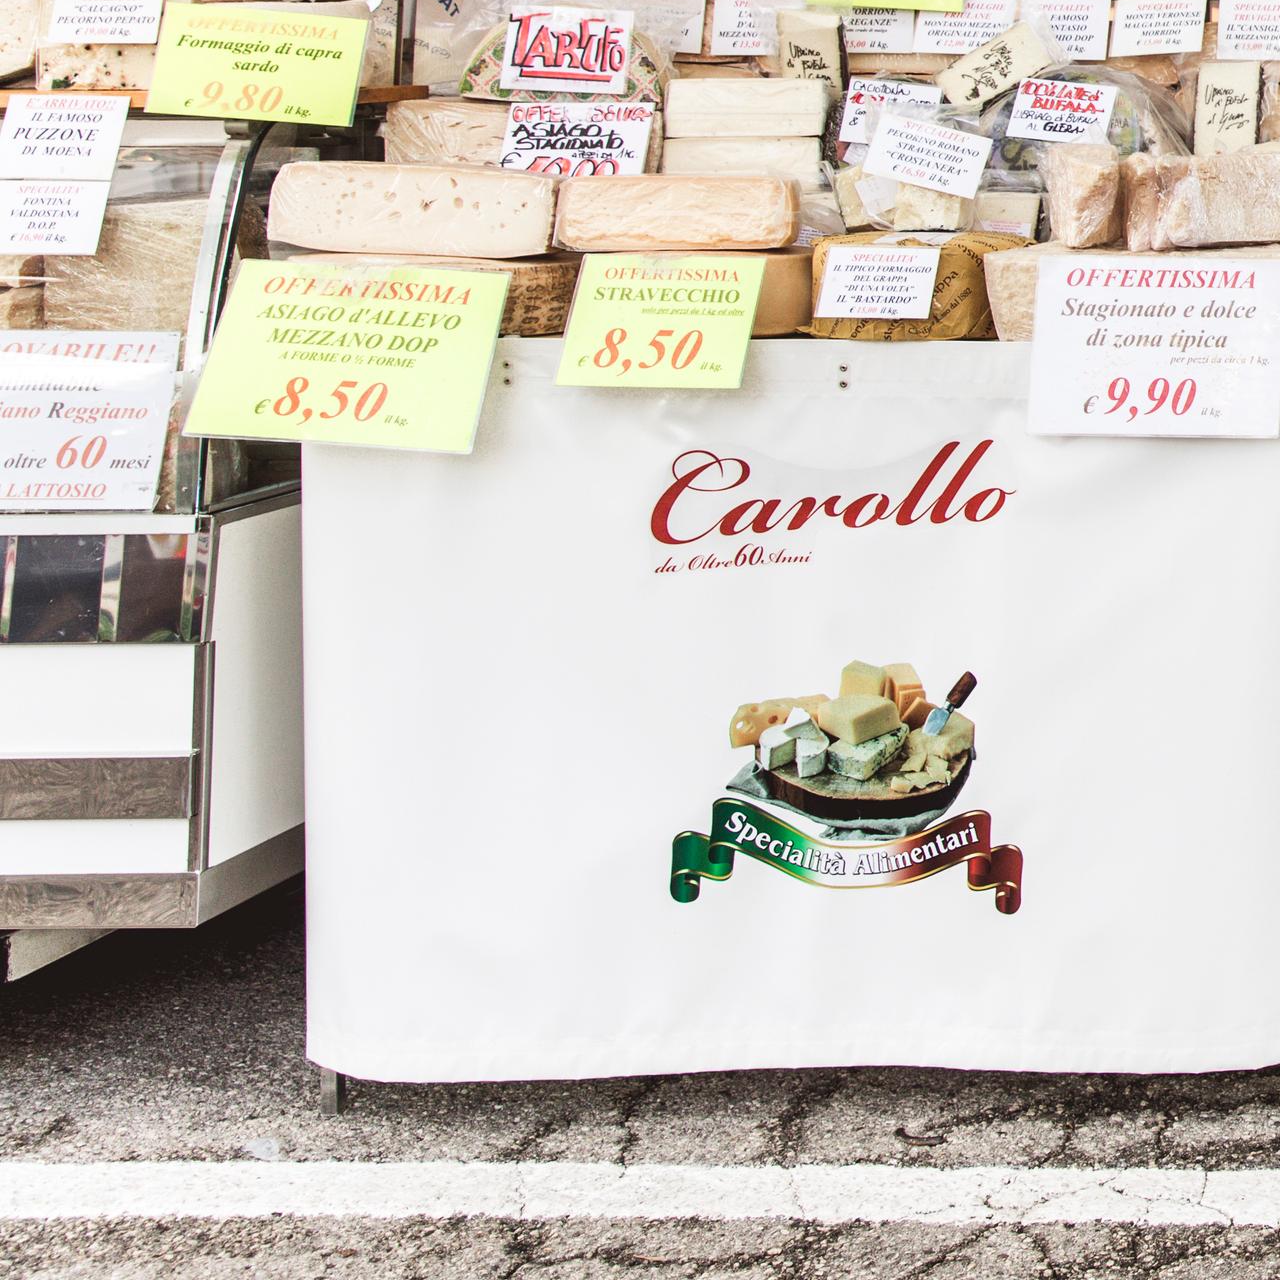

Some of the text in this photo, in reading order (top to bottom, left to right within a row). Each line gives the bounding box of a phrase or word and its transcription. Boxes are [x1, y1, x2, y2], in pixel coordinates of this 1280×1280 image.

[187, 17, 340, 40] OFFERTISSIMA
[177, 33, 344, 61] Formaggio di capra
[232, 59, 280, 74] sardo
[46, 113, 104, 123] FAMOSO
[13, 127, 99, 142] PUZZONE
[512, 122, 602, 138] ASIAGO
[21, 146, 93, 157] DI MOENA
[886, 128, 981, 158] PECORINO ROMANO
[897, 140, 963, 164] STRAVECCHIO
[23, 197, 72, 206] FONTINA
[10, 209, 80, 219] VALDOSTANA
[852, 253, 917, 262] SPECIALITA'
[604, 266, 740, 284] OFFERTISSIMA
[1066, 267, 1256, 289] OFFERTISSIMA
[264, 275, 473, 306] OFFERTISSIMA
[593, 287, 740, 304] STRAVECCHIO
[256, 305, 463, 331] ASIAGO d'ALLEVO
[1061, 297, 1257, 322] Stagionato e dolce
[267, 327, 439, 353] MEZZANO DOP
[1086, 328, 1228, 353] di zona tipica
[292, 350, 416, 369] FORME FORME
[593, 327, 704, 377] 8,50
[255, 376, 389, 426] € 8,50
[1083, 377, 1197, 423] € 9,90
[48, 401, 149, 424] Reggiano
[4, 435, 152, 470] oltre 60 mesi
[6, 482, 107, 499] LATTOSIO
[650, 439, 1016, 545] Carollo
[723, 811, 980, 876] Specialità Alimentari
